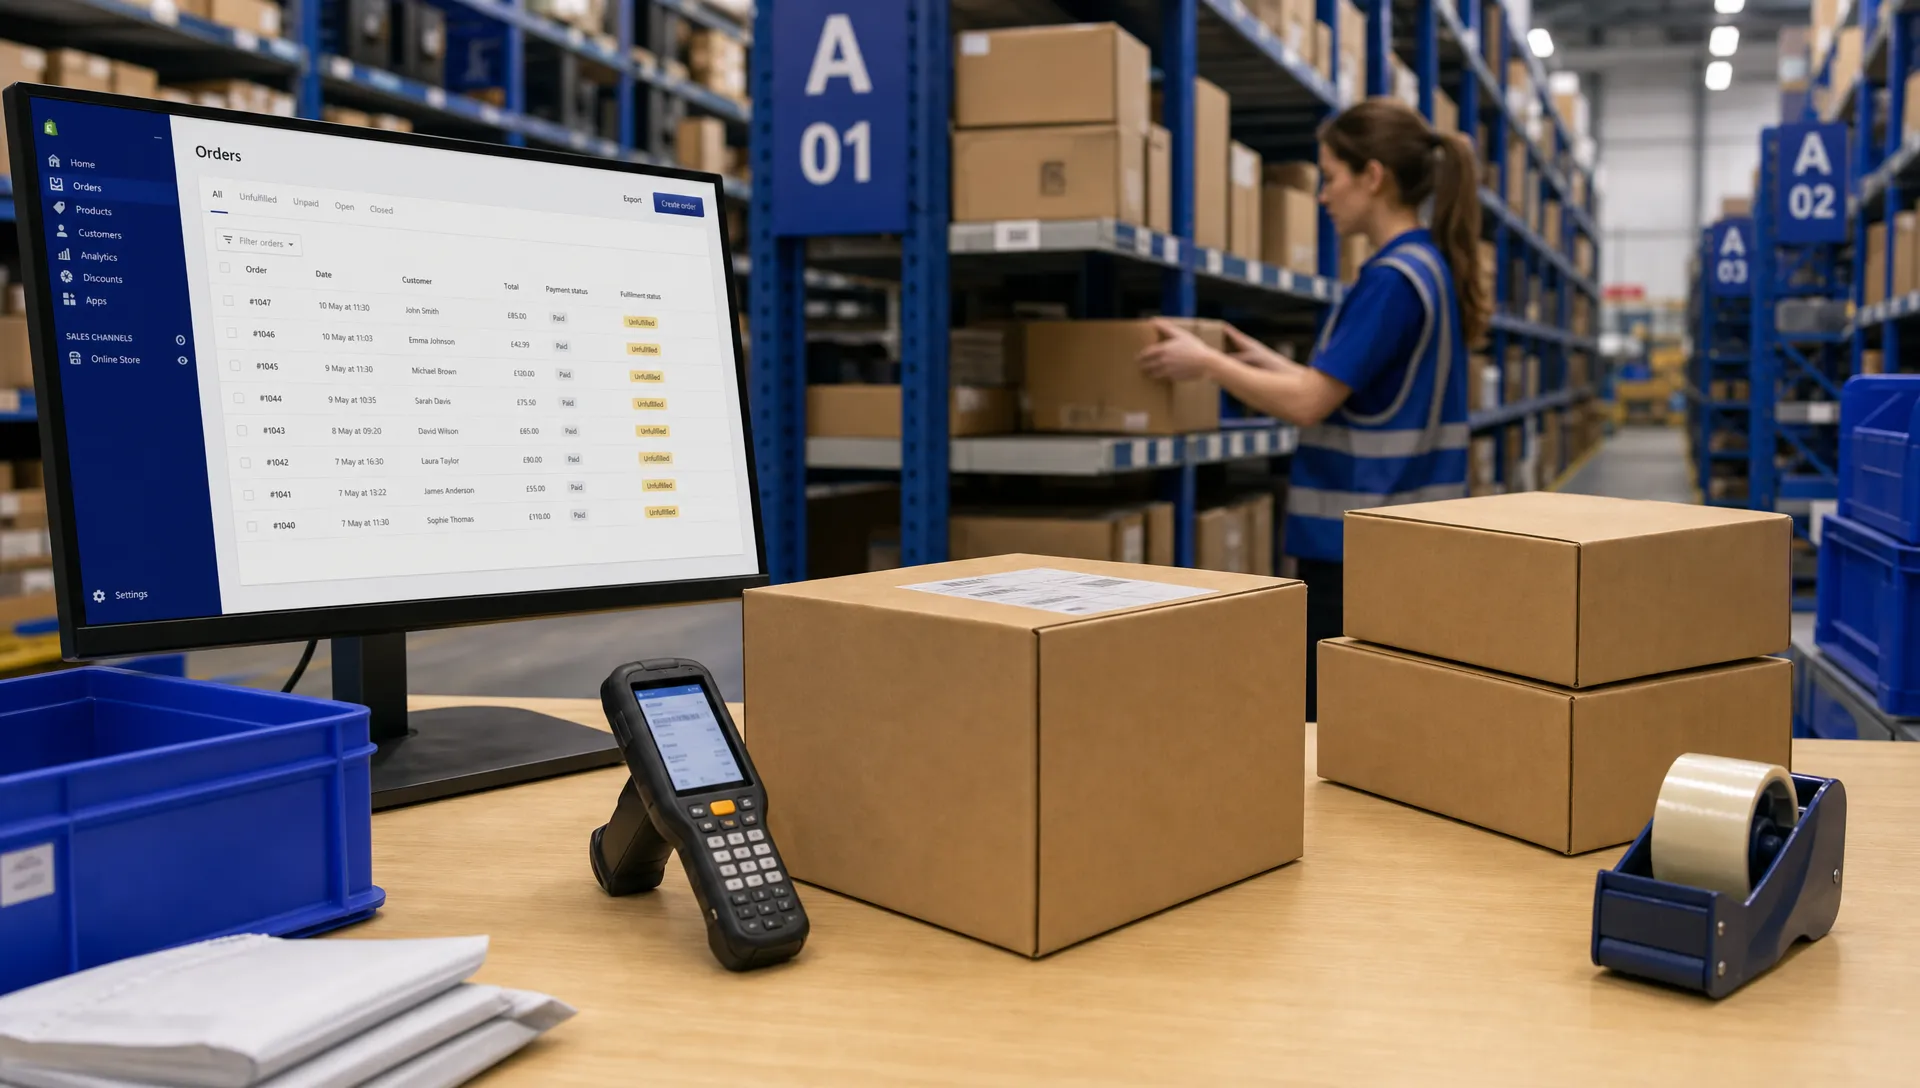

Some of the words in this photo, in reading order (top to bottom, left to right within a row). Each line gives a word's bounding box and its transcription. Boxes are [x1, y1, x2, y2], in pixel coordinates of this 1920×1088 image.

[805, 13, 874, 96] A
[195, 145, 241, 162] Orders
[800, 120, 872, 185] 01
[1793, 132, 1832, 176] A
[70, 158, 96, 169] Home
[73, 182, 102, 193] Orders
[212, 190, 222, 198] All
[239, 192, 277, 203] Unfulfilled
[293, 197, 319, 208] Unpaid
[623, 195, 642, 204] Export
[1788, 184, 1836, 220] 02
[75, 205, 112, 217] Products
[335, 201, 355, 213] Open
[369, 204, 393, 215] Closed
[78, 228, 122, 240] Customers
[239, 237, 257, 247] Filter
[259, 238, 284, 249] orders
[1720, 227, 1747, 256] A
[80, 251, 118, 263] Analytics
[245, 264, 267, 275] Order
[315, 269, 332, 279] Date
[1717, 260, 1749, 284] 03
[83, 273, 123, 284] Discounts
[402, 275, 432, 286] Customer
[504, 283, 519, 291] Total
[546, 286, 570, 295] Payment
[86, 295, 107, 307] Apps
[249, 298, 271, 306] #1047
[327, 302, 343, 311] May
[353, 303, 370, 312] 11:30
[405, 306, 420, 314] John
[421, 307, 439, 315] Smith
[553, 314, 565, 322] Paid
[66, 332, 89, 341] SALES
[91, 333, 133, 342] CHANNELS
[253, 330, 275, 338] #1046
[331, 334, 346, 343] May
[357, 334, 373, 342] 11:03
[91, 354, 118, 364] Online
[119, 356, 141, 364] Store
[256, 362, 279, 370] #1045
[331, 365, 346, 374] May
[357, 365, 373, 373] 11:30
[412, 367, 436, 375] Michael
[559, 371, 571, 379] Paid
[260, 394, 282, 402] #1044
[334, 396, 350, 405] May
[360, 396, 376, 404] 10:35
[415, 397, 433, 405] Sarah
[562, 399, 574, 407] Paid
[263, 427, 285, 435] #1043
[338, 428, 353, 437] May
[363, 427, 382, 435] 09:20
[267, 458, 289, 467] #1042
[341, 458, 356, 467] May
[367, 458, 384, 466] 16:30
[440, 457, 459, 466] Taylor
[344, 490, 359, 499] May
[370, 489, 387, 497] 13:22
[424, 487, 444, 495] James
[445, 487, 474, 495] Anderson
[526, 485, 546, 493] £55.00
[270, 491, 291, 499] #1041
[427, 516, 449, 525] Sophie
[450, 515, 474, 524] Thomas
[574, 511, 586, 519] Paid
[273, 522, 296, 530] #1040
[347, 520, 363, 529] May
[373, 518, 389, 526] 11:30
[115, 591, 148, 600] Settings
